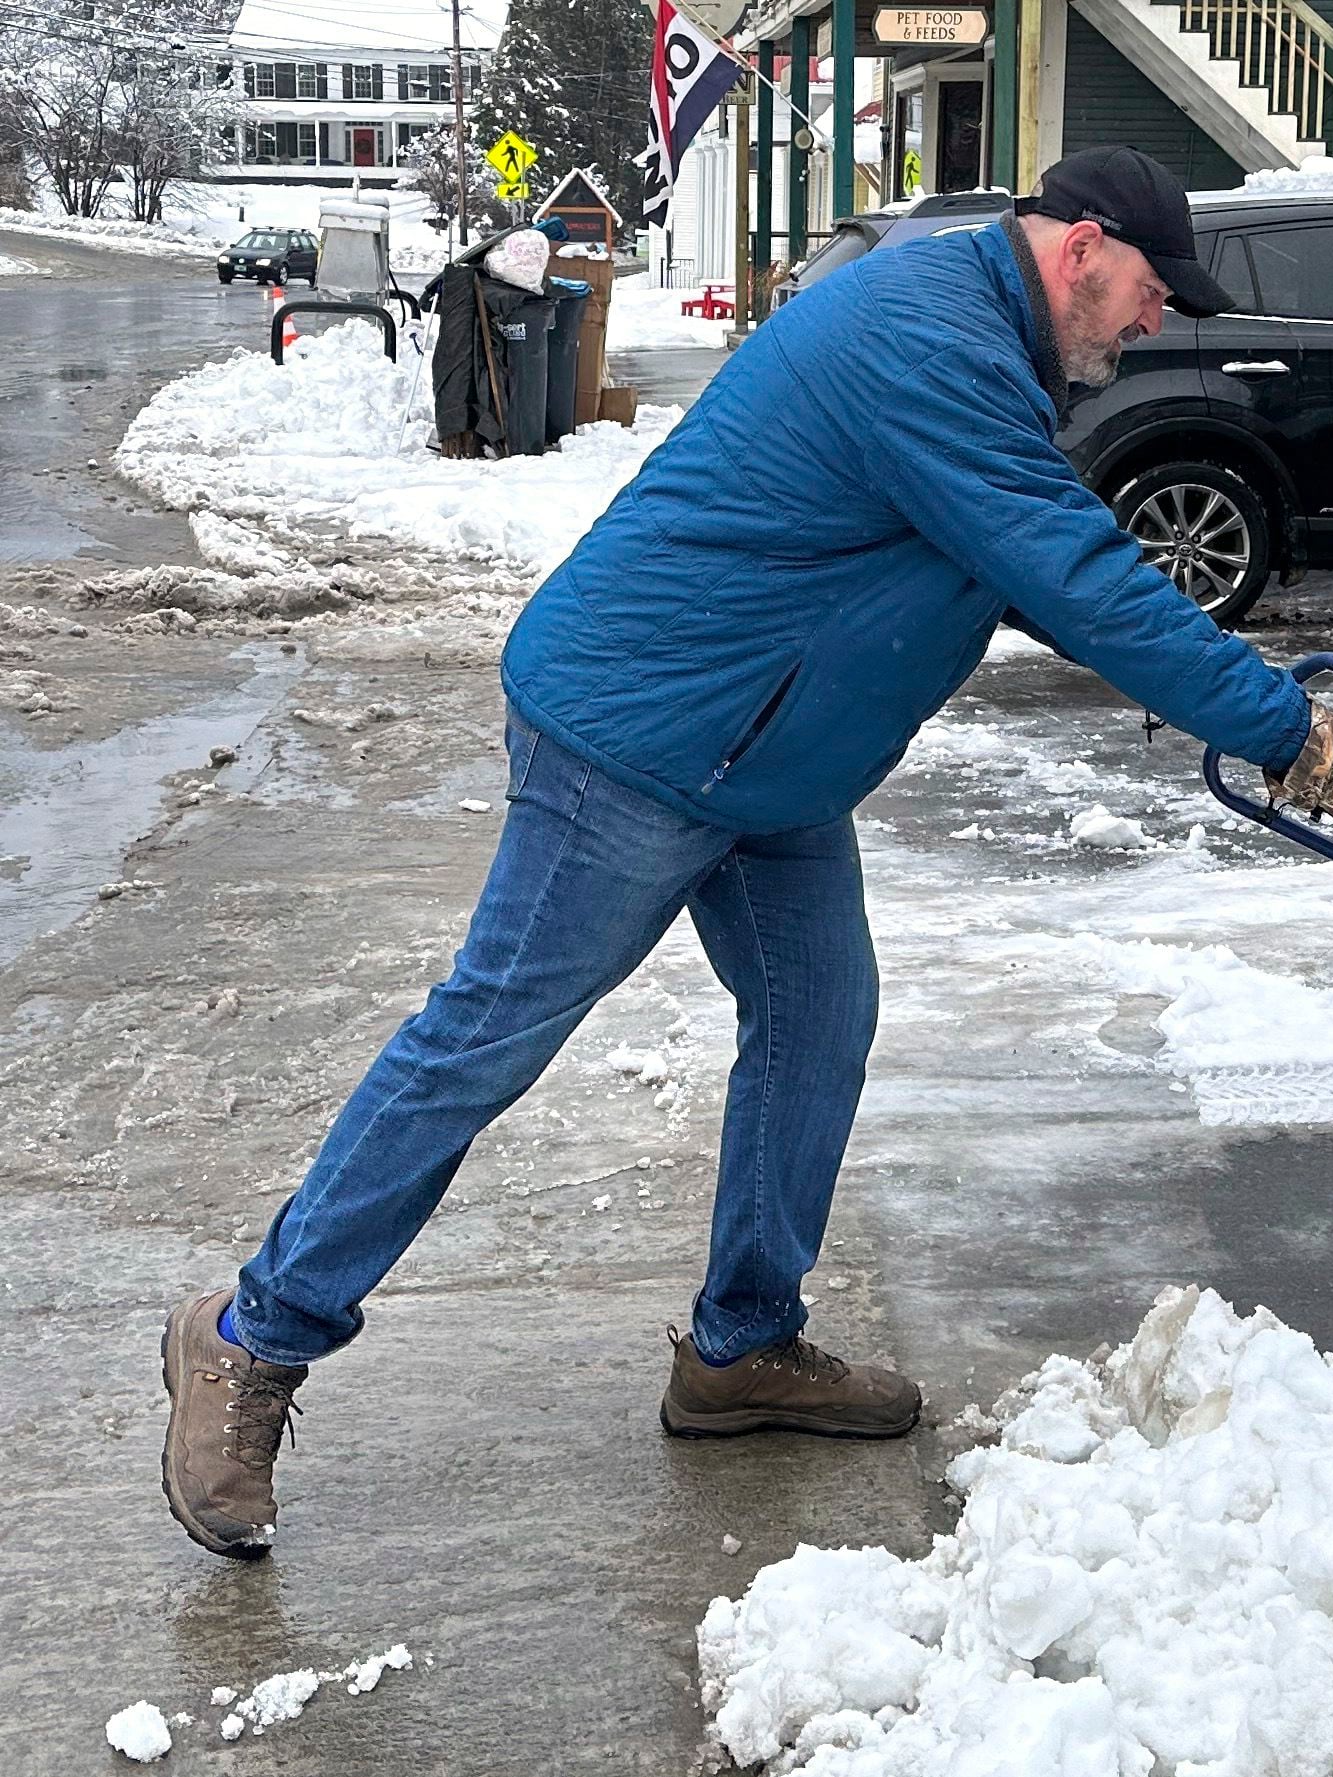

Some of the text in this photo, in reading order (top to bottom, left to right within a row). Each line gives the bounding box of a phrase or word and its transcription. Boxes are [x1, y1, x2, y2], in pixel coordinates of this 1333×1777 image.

[897, 12, 962, 25] PET FOOD
[903, 27, 955, 40] & FEEDS
